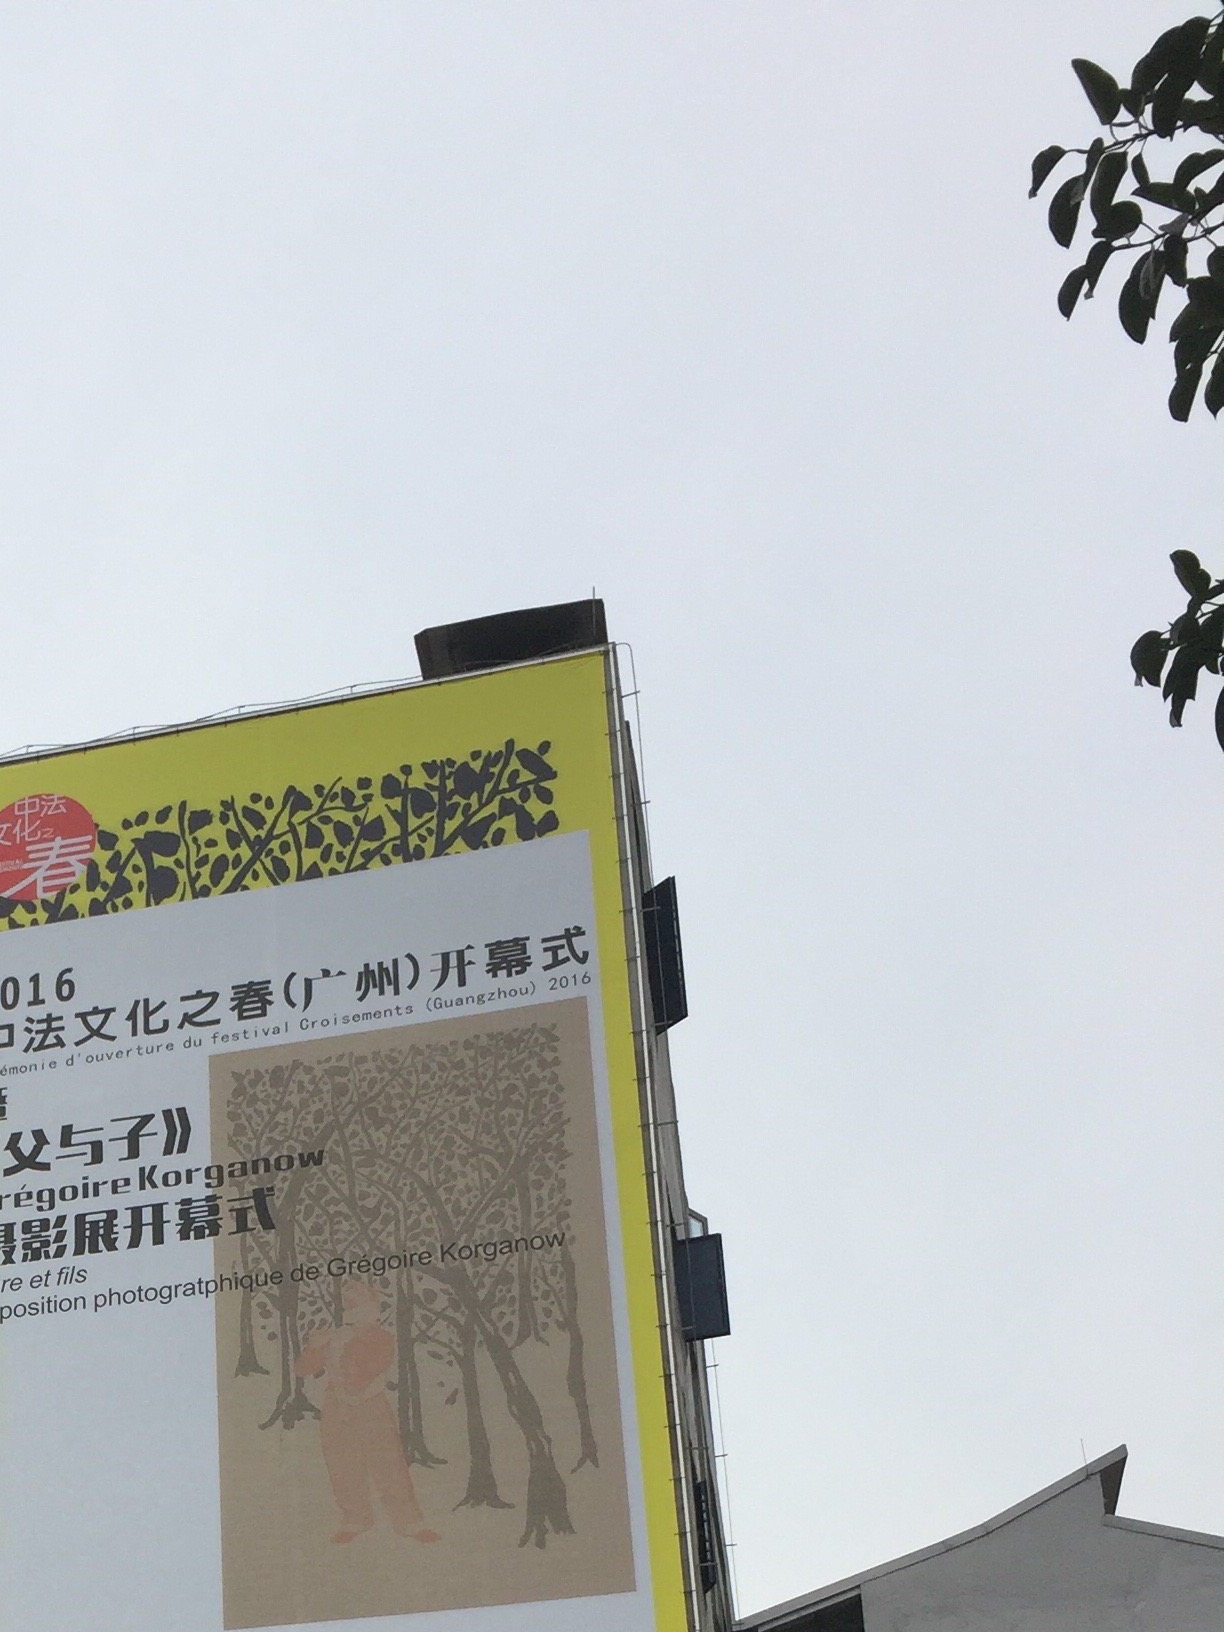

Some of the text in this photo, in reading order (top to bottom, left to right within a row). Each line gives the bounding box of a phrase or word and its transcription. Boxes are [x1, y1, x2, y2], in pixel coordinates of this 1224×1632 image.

[14, 794, 67, 819] 中法
[0, 836, 93, 899] 春
[65, 1040, 175, 1067] d'ouverture
[182, 1036, 203, 1049] du
[211, 1022, 289, 1045] festival
[299, 1004, 414, 1031] Croisements
[426, 980, 536, 1012] (Guangzhou)
[548, 971, 591, 991] 2016
[138, 1149, 325, 1191] Korganow
[29, 1269, 52, 1289] et
[56, 1266, 88, 1286] fils
[94, 1268, 283, 1314] photogratphique
[290, 1263, 320, 1283] de
[327, 1249, 432, 1277] Grégoire
[440, 1231, 566, 1263] Korganow
